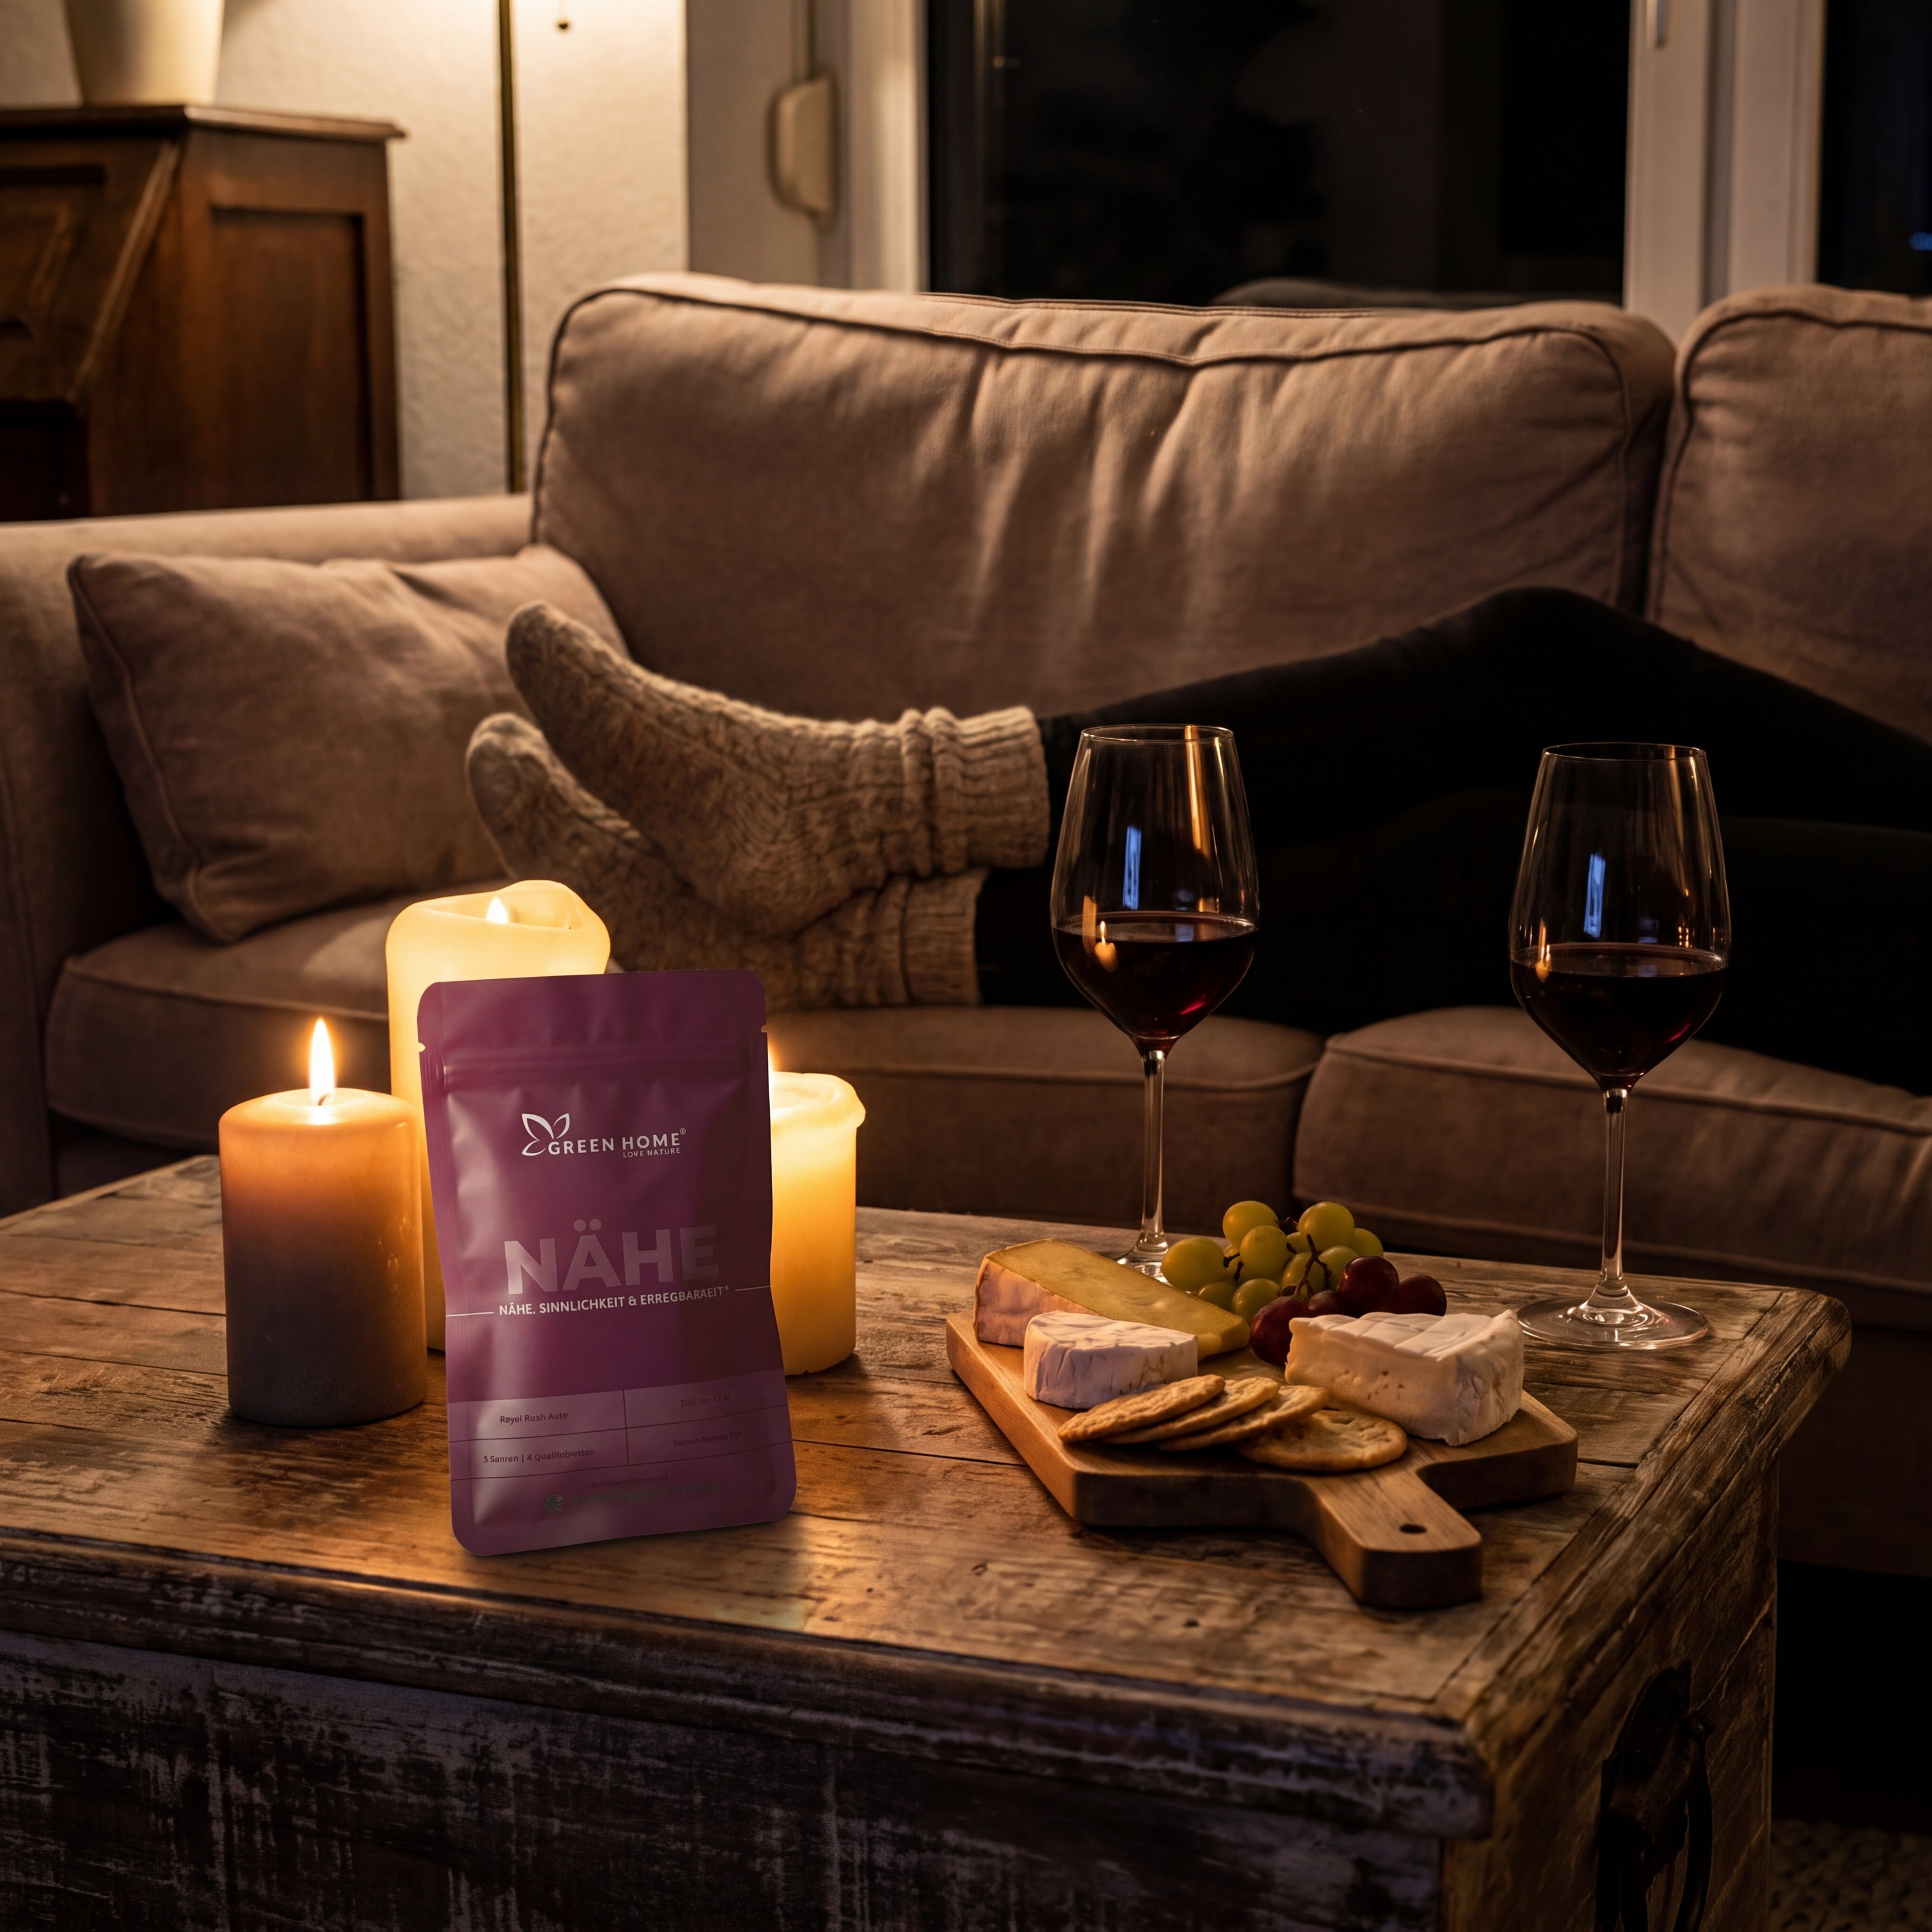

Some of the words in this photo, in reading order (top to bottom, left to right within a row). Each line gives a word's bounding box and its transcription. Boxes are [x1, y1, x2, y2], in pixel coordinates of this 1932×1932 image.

[548, 1137, 615, 1156] GREEN
[647, 1147, 681, 1156] NATURE
[504, 1218, 719, 1295] NÄHE
[539, 1296, 625, 1314] SINNLICHKEIT
[628, 1296, 638, 1307] &
[525, 1413, 546, 1422] Rush
[548, 1412, 569, 1420] Aute
